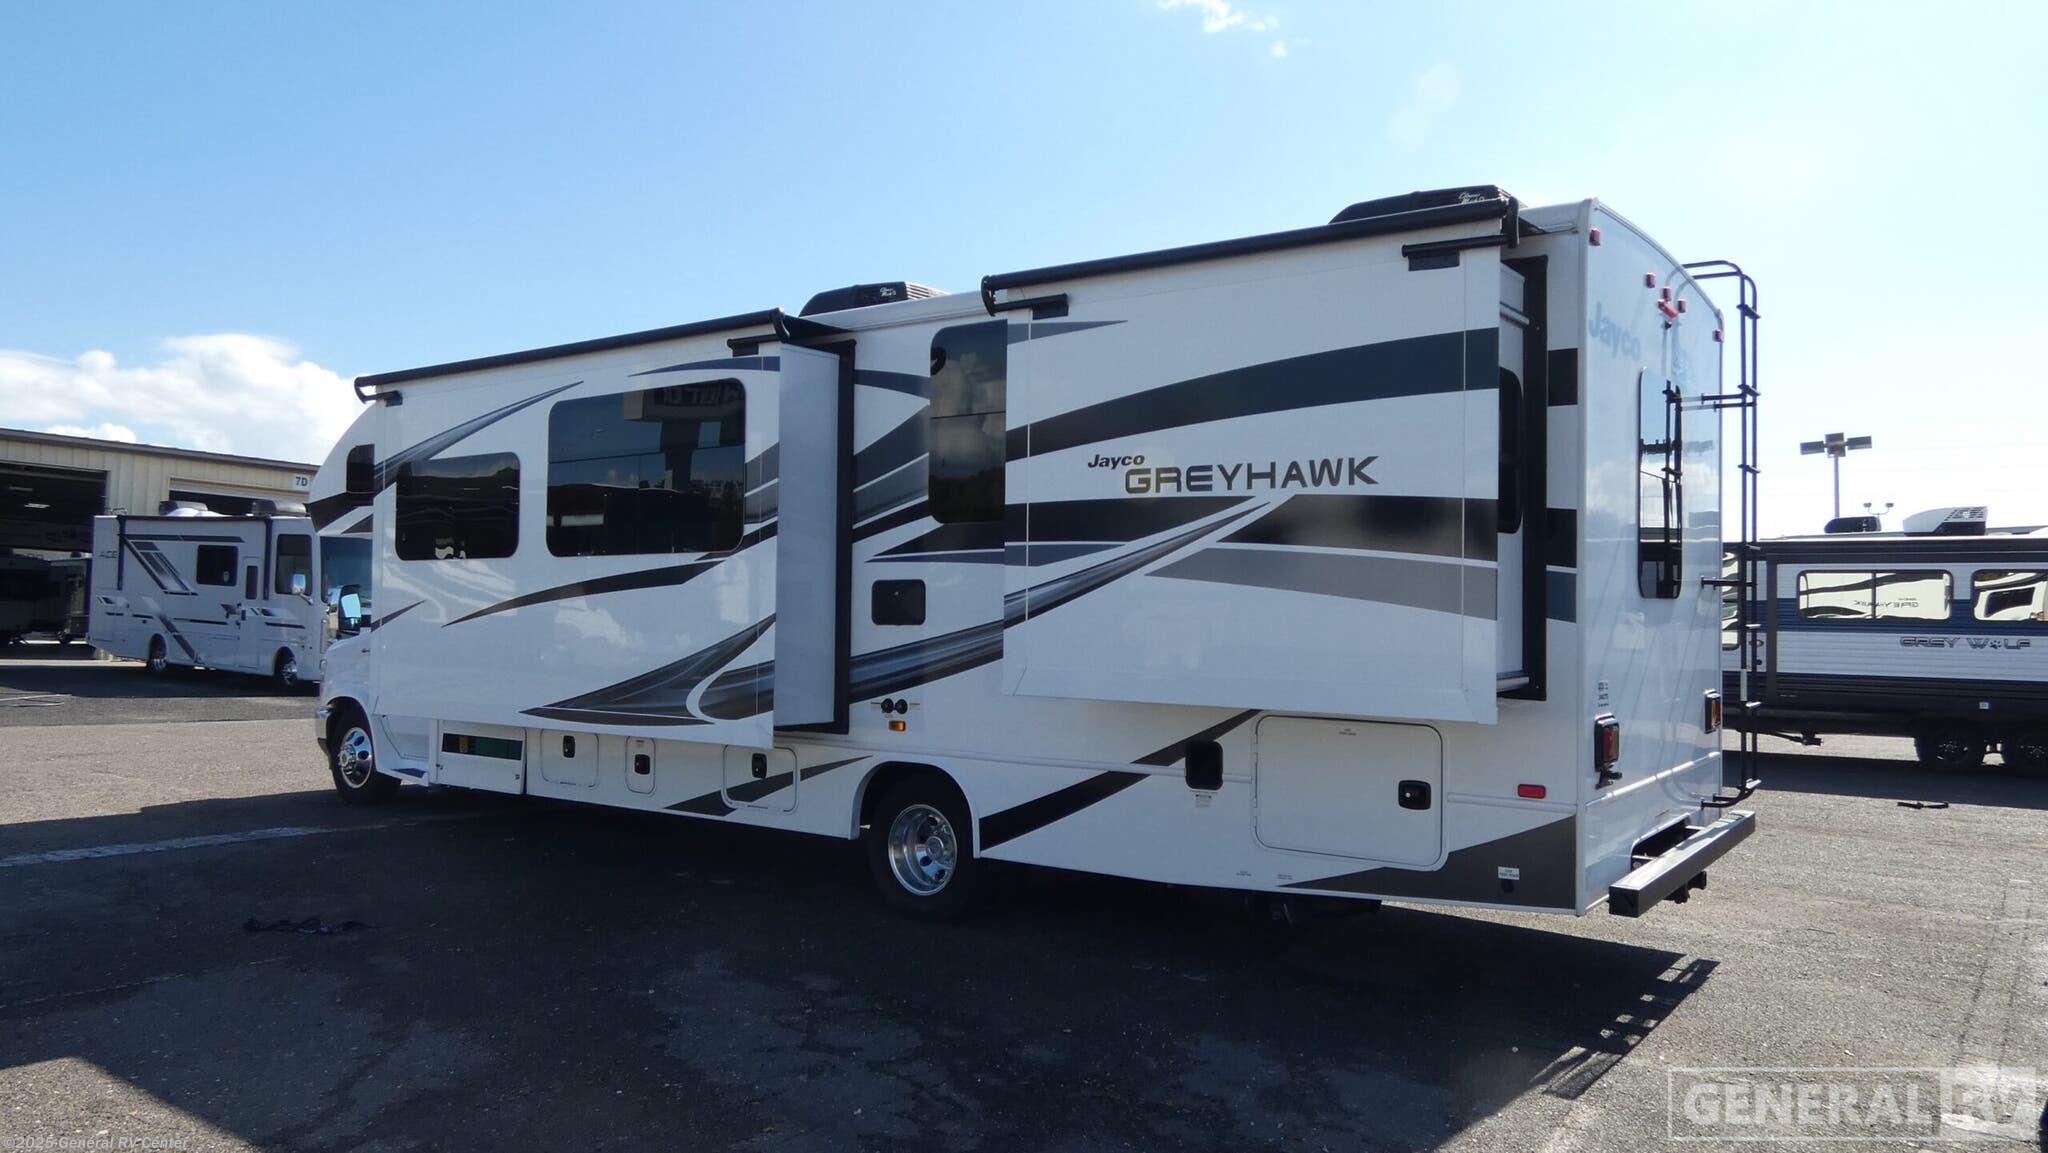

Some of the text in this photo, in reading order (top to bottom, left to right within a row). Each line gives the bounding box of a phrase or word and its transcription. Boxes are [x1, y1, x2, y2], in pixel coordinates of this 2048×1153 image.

[1589, 301, 1641, 361] Jayco
[1088, 454, 1145, 470] Jayco
[1125, 456, 1379, 494] GREYHAWK
[1900, 637, 1961, 649] GREY
